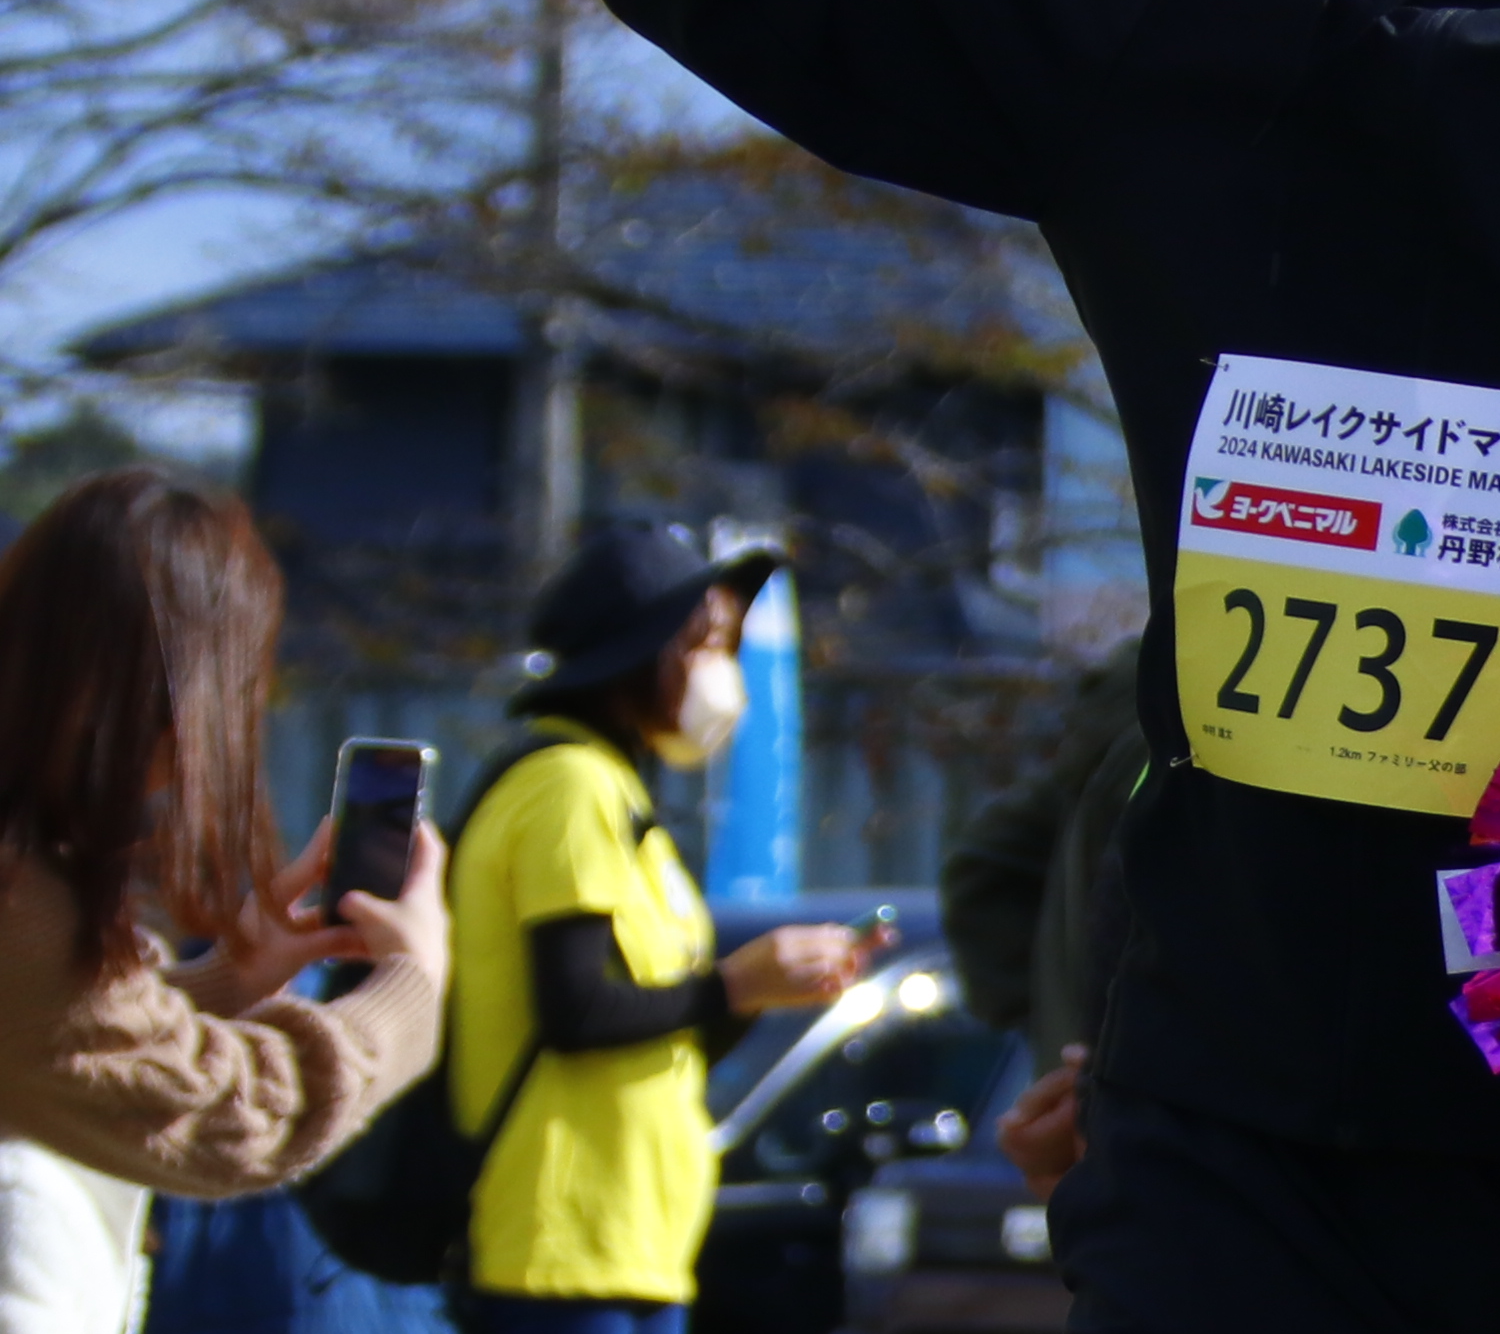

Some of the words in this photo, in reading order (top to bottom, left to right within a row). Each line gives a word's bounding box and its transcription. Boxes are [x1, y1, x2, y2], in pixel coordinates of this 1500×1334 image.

[1217, 436, 1257, 460] 2024
[1261, 441, 1355, 473] KAWASAKI
[1360, 453, 1462, 488] LAKESIDE
[1230, 494, 1357, 537] ヨークベニマル
[1216, 588, 1499, 741] 2737
[1329, 746, 1362, 760] 1.2km
